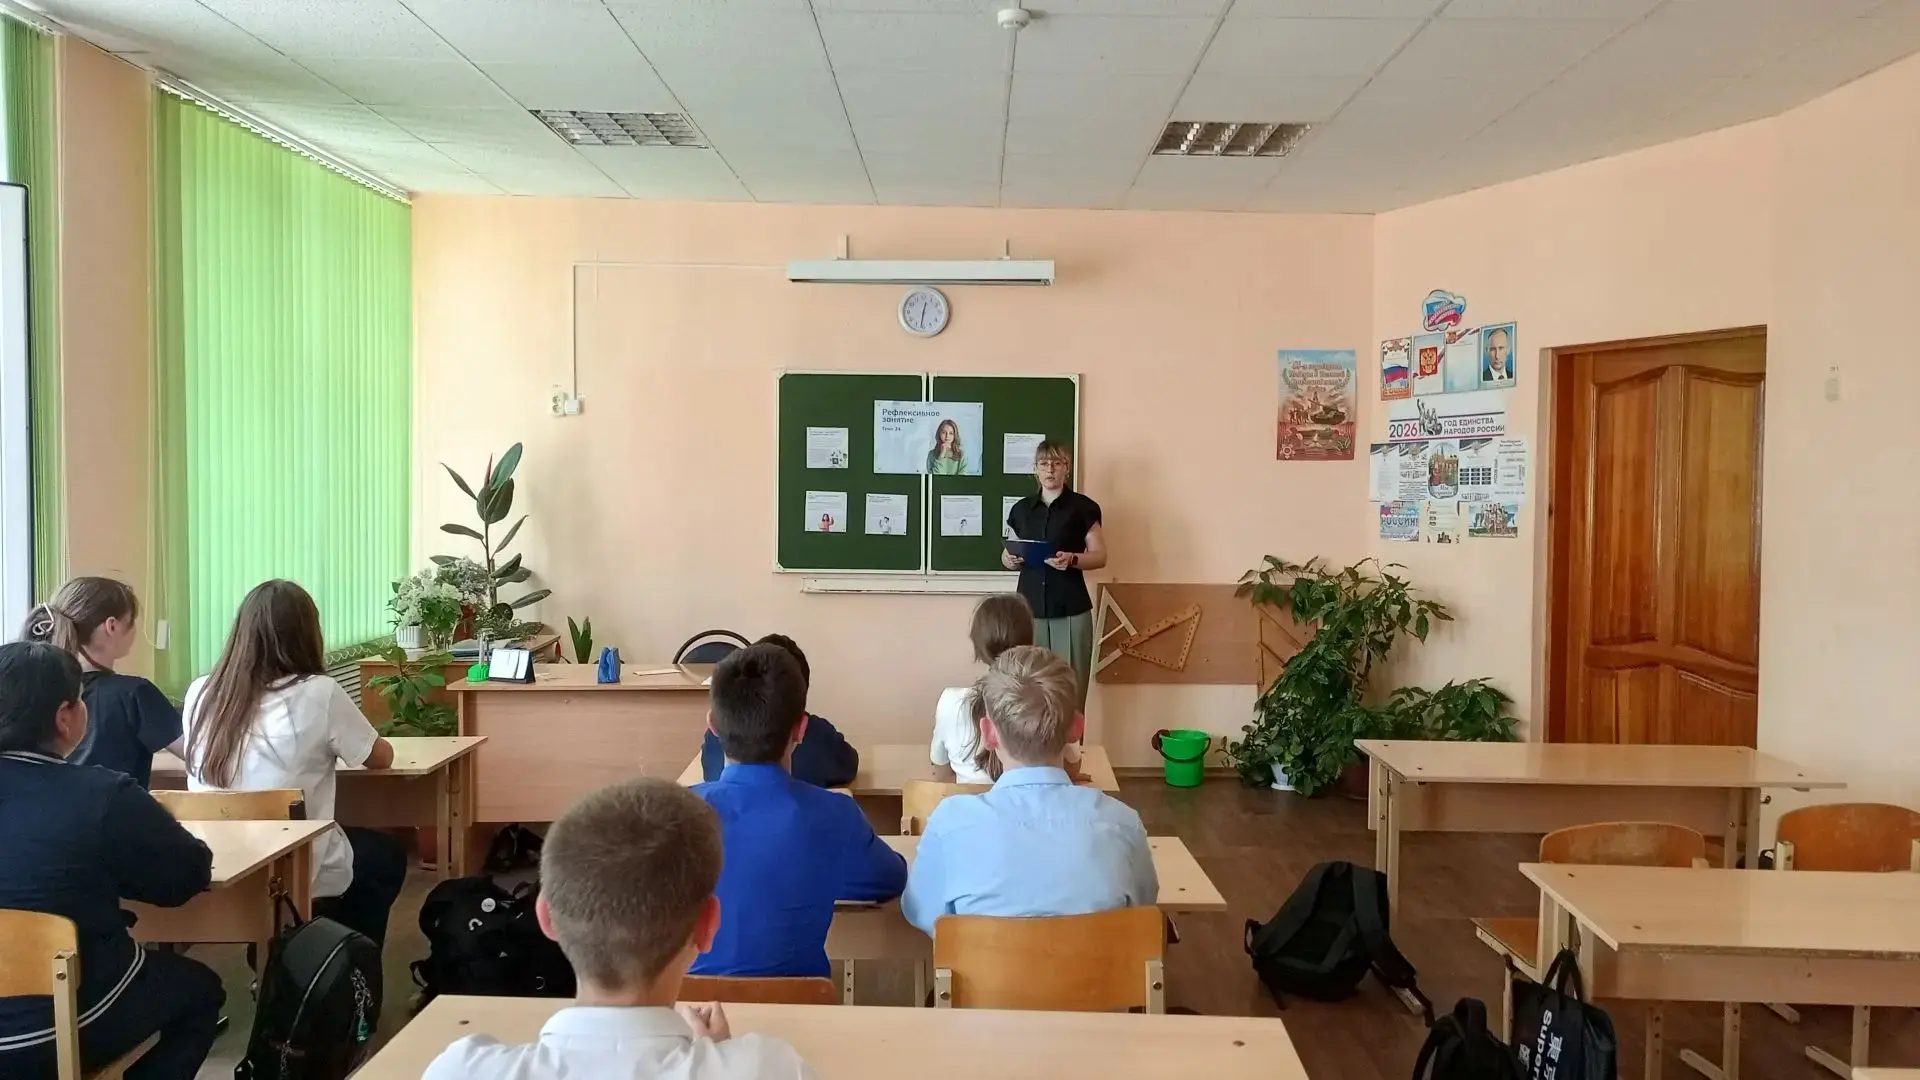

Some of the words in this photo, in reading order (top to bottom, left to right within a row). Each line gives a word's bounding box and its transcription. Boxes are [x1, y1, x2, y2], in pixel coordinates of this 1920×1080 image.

[882, 408, 940, 417] Рефлексивное
[1459, 417, 1494, 426] ЕДИНСТВА
[1389, 423, 1418, 438] 2026
[1443, 426, 1475, 435] НАРОДОВ
[1476, 424, 1505, 433] РОССИИ
[1532, 1009, 1552, 1080] Super
